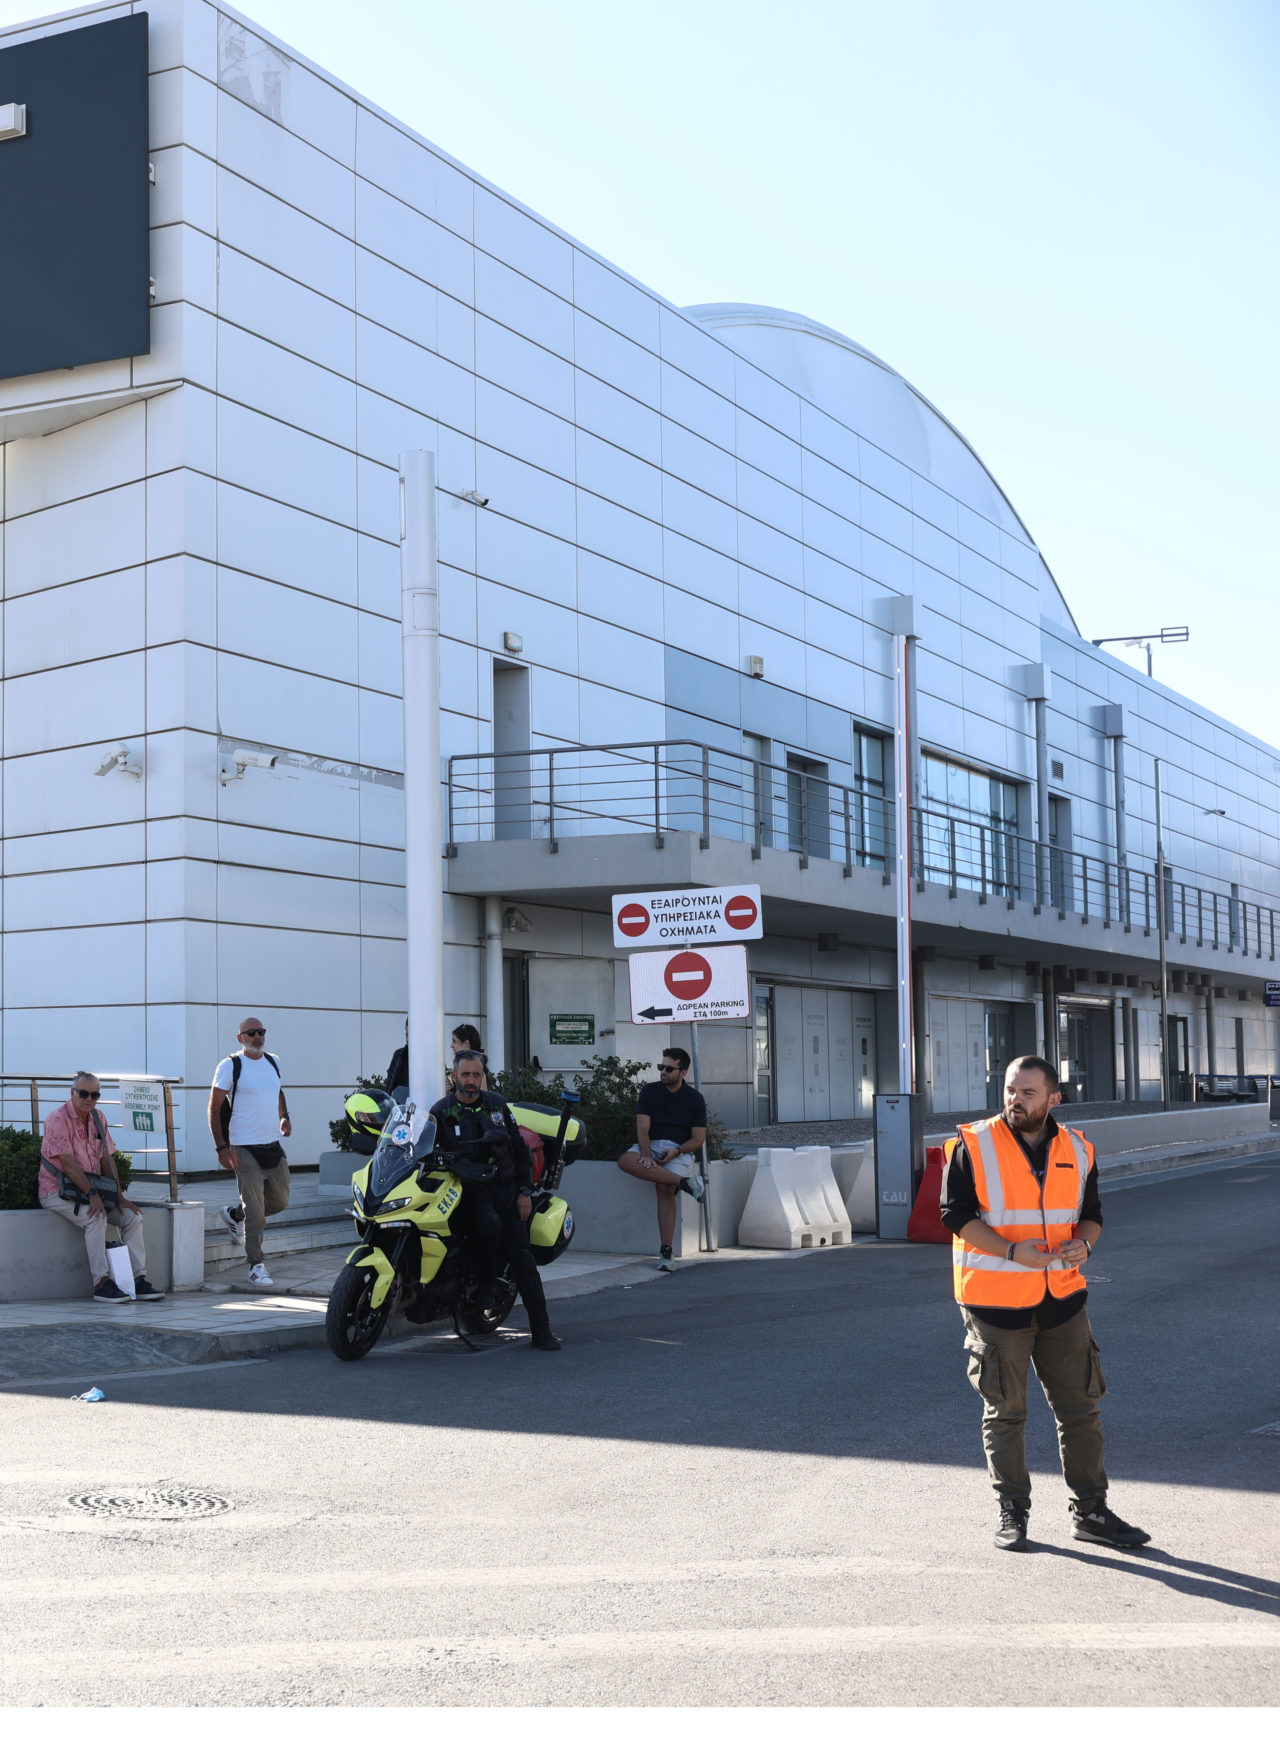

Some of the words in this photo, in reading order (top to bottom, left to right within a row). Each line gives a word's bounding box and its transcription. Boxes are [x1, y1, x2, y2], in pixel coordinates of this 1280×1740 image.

[651, 895, 722, 909] ΕΞΑΙΡΟΥΝΤΑΙ
[653, 910, 721, 923] ΥΠΗΡΕΣΙΑΚΑ
[659, 924, 717, 937] ΟΧΗΜΑΤΑ
[677, 1002, 709, 1011] ΔΩΡΕΑΝ
[710, 1000, 745, 1008] PARKING
